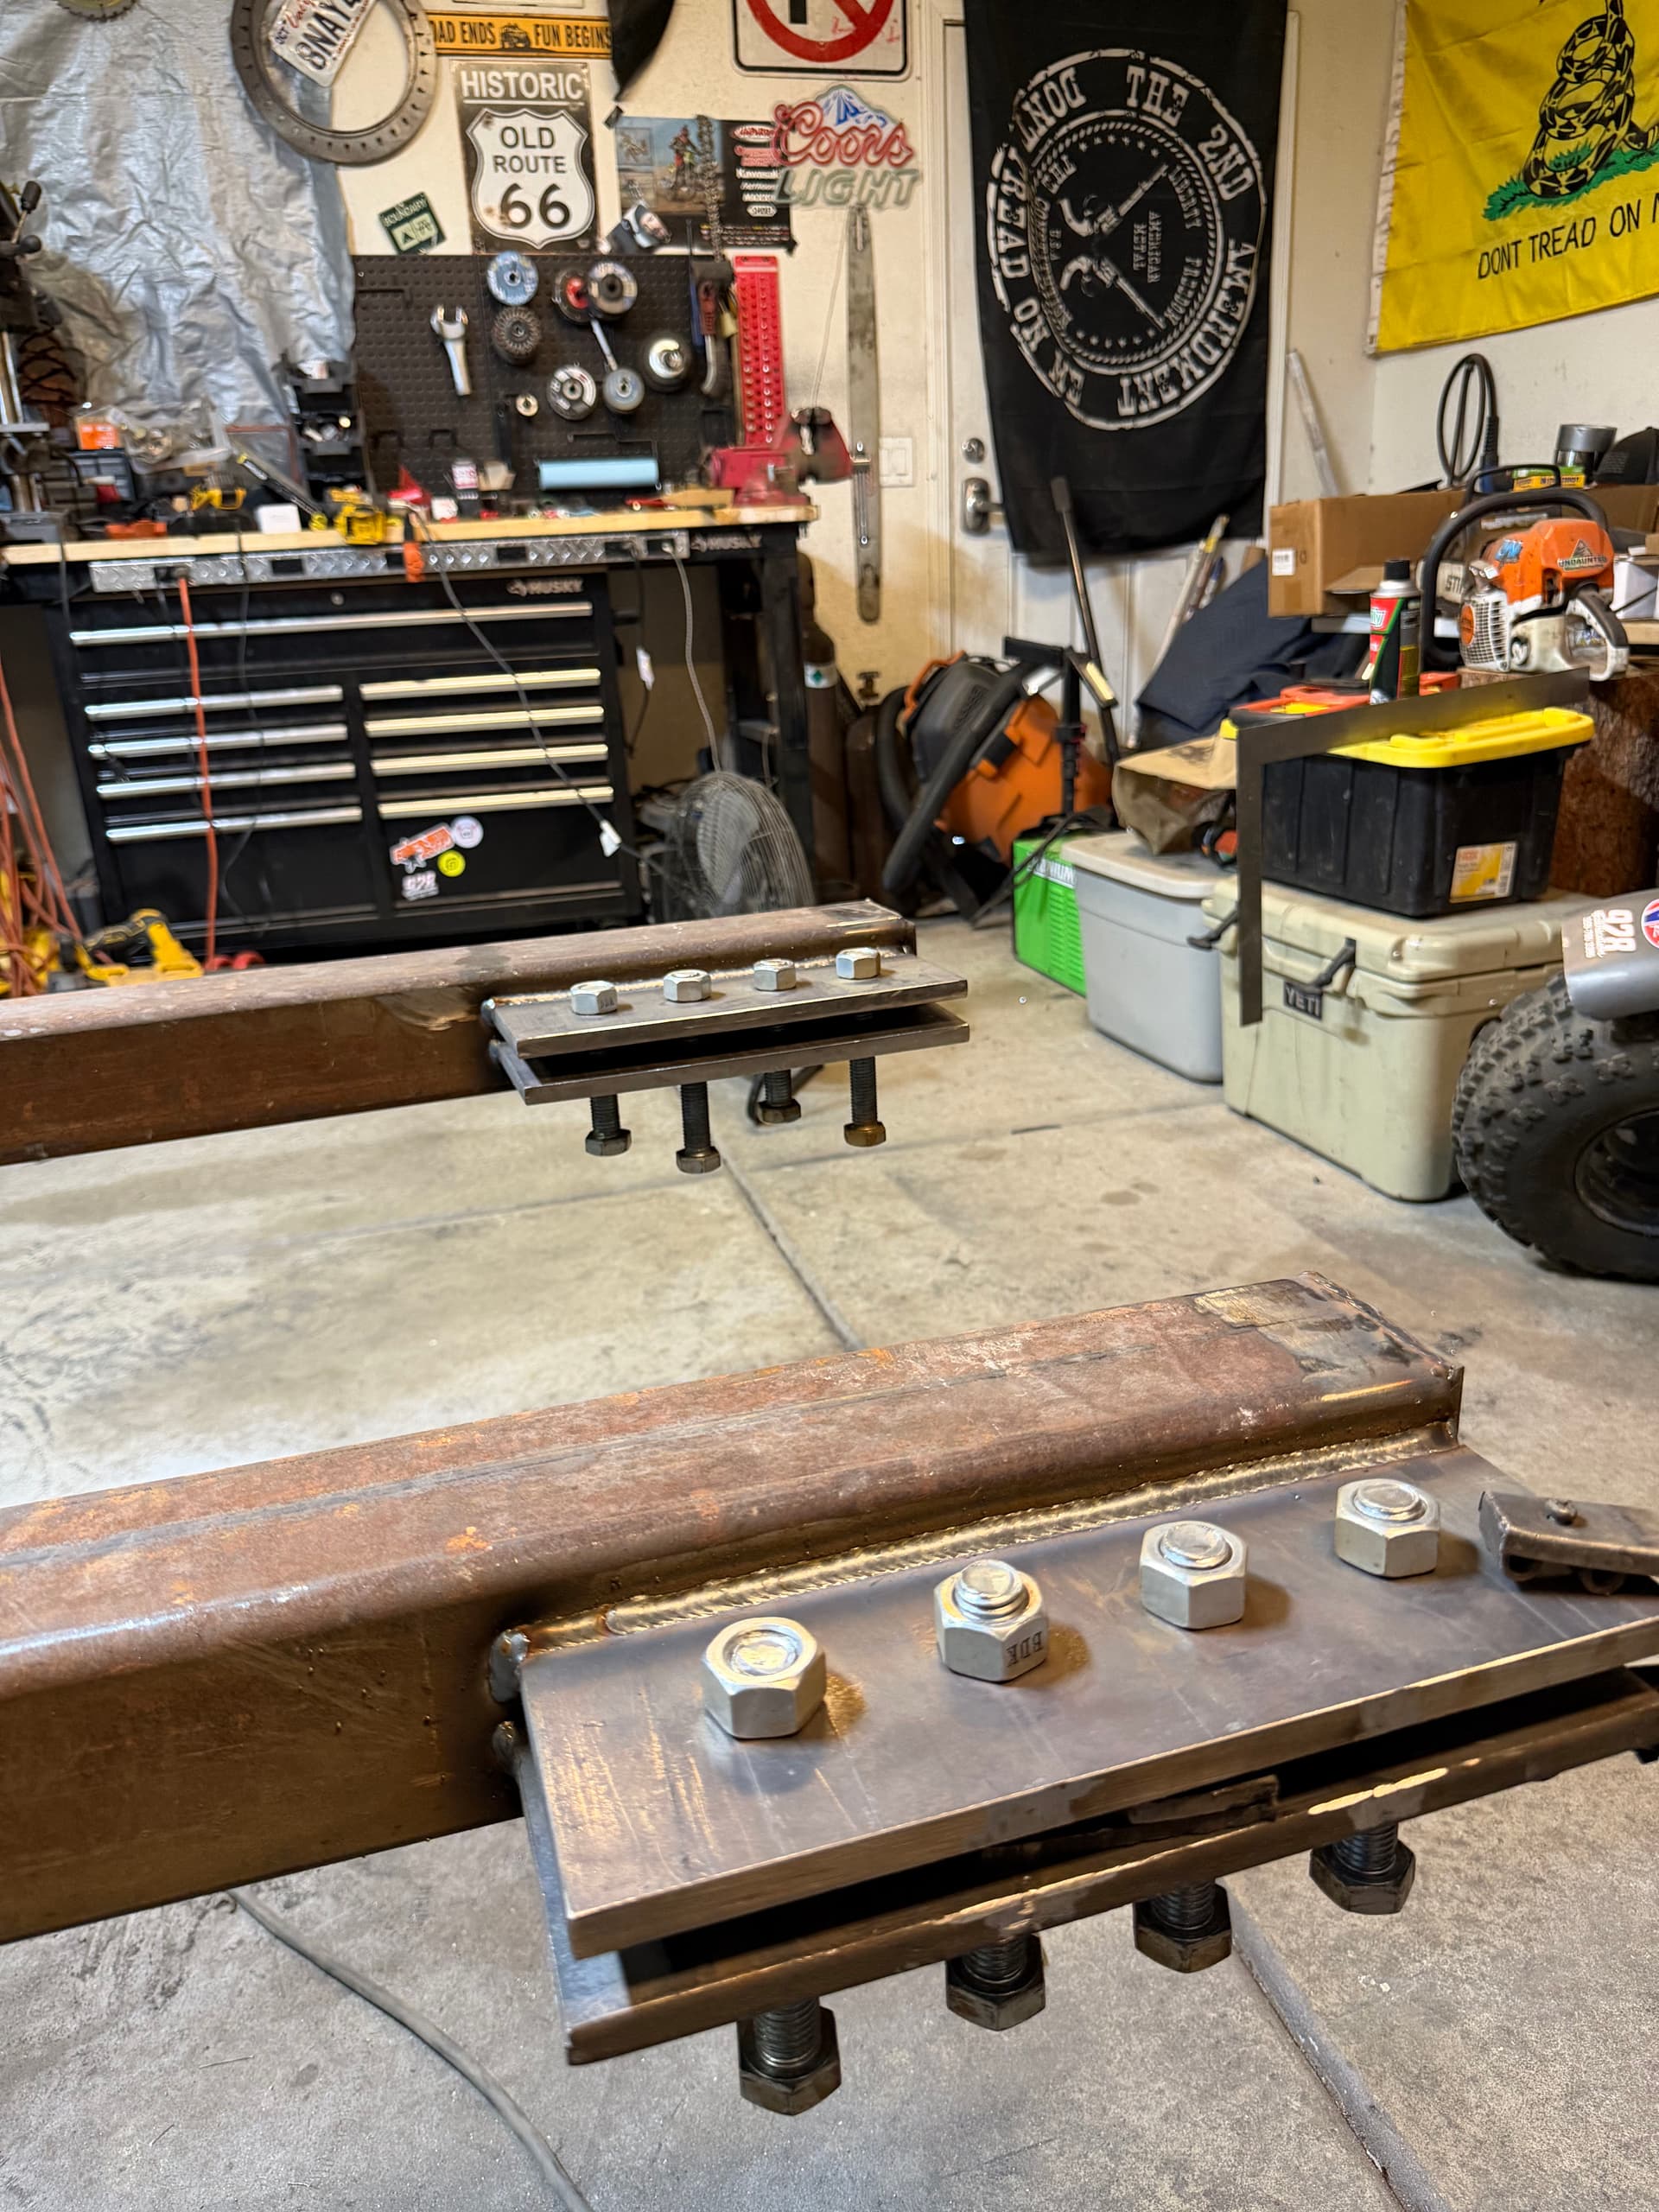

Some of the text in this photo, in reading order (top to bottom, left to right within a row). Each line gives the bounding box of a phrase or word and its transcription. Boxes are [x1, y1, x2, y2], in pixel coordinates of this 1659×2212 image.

[429, 20, 612, 48] OAD ENDS FUN BEGINS
[460, 69, 583, 99] HISTORIC
[499, 125, 555, 149] OLD
[772, 100, 913, 168] Coors
[493, 155, 567, 175] ROUTE
[773, 168, 920, 207] LIGHT
[499, 182, 571, 229] 66
[996, 67, 1087, 407] DONT TREAD ON ME
[1117, 65, 1258, 416] THE 2ND AMENDMENT
[1132, 223, 1147, 271] METAL
[1147, 210, 1162, 284] AMERICAN
[1163, 166, 1204, 327] LIBERTY FREEDOM
[1477, 239, 1522, 280] DONT
[1528, 217, 1597, 263] TREAD
[1608, 199, 1642, 238] ON
[1285, 986, 1320, 1018] YETI
